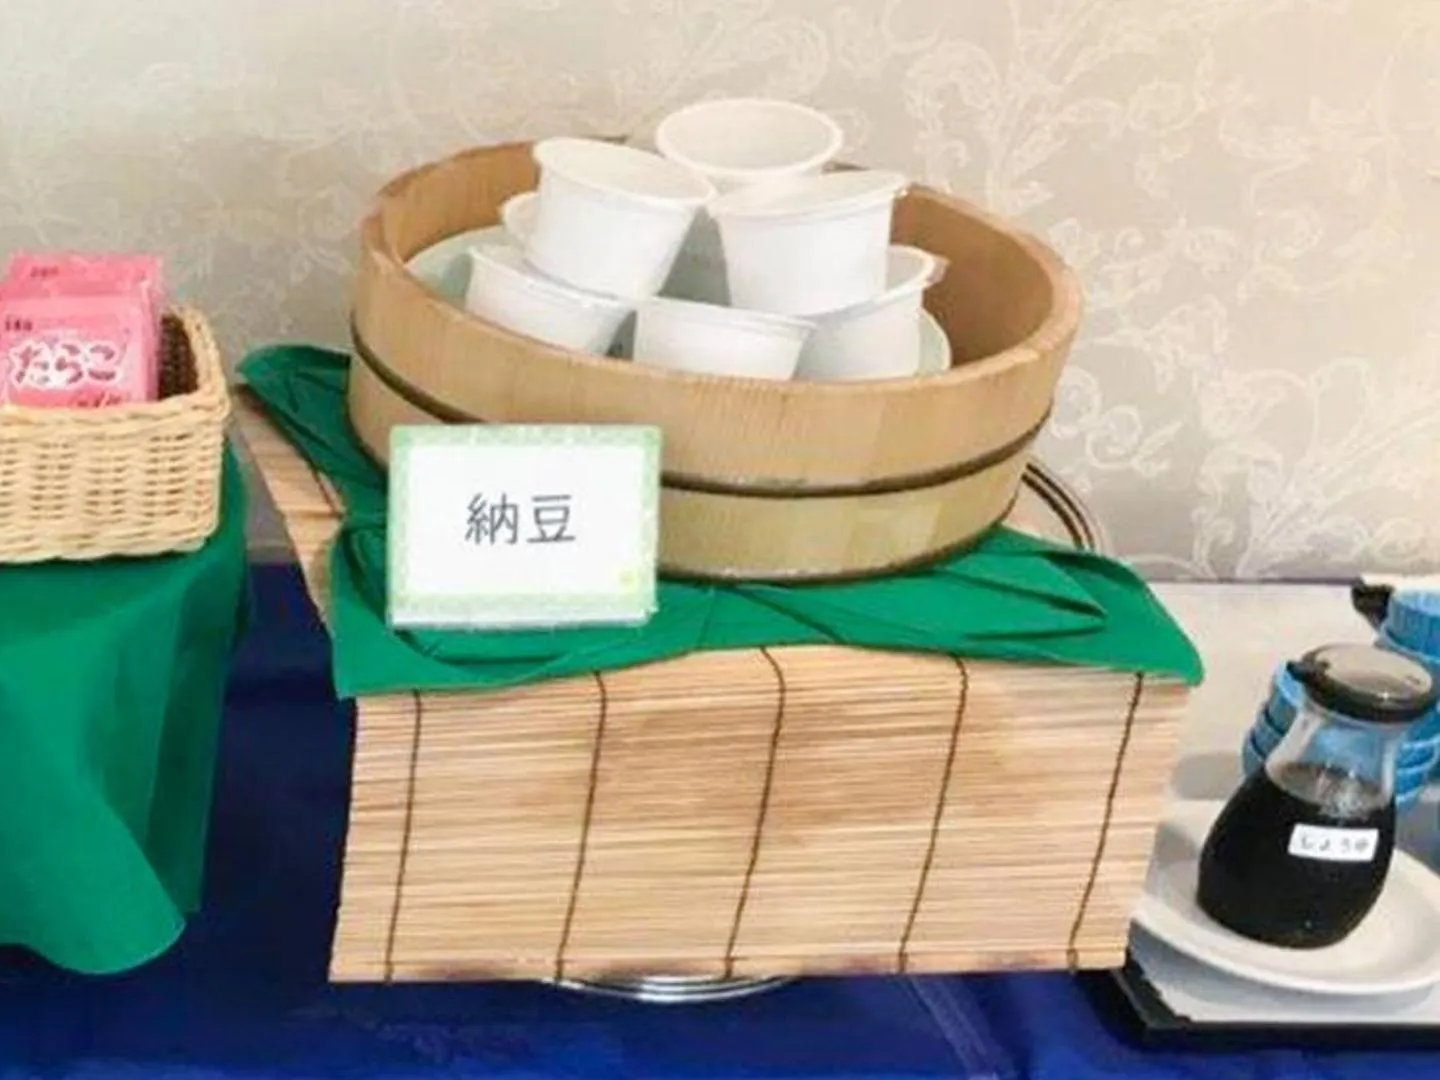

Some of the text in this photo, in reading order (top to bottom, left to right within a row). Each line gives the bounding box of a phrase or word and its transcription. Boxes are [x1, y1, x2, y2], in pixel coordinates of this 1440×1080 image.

[12, 343, 117, 385] たらこ
[464, 492, 576, 545] 納豆
[1299, 832, 1370, 854] しょうゆ
